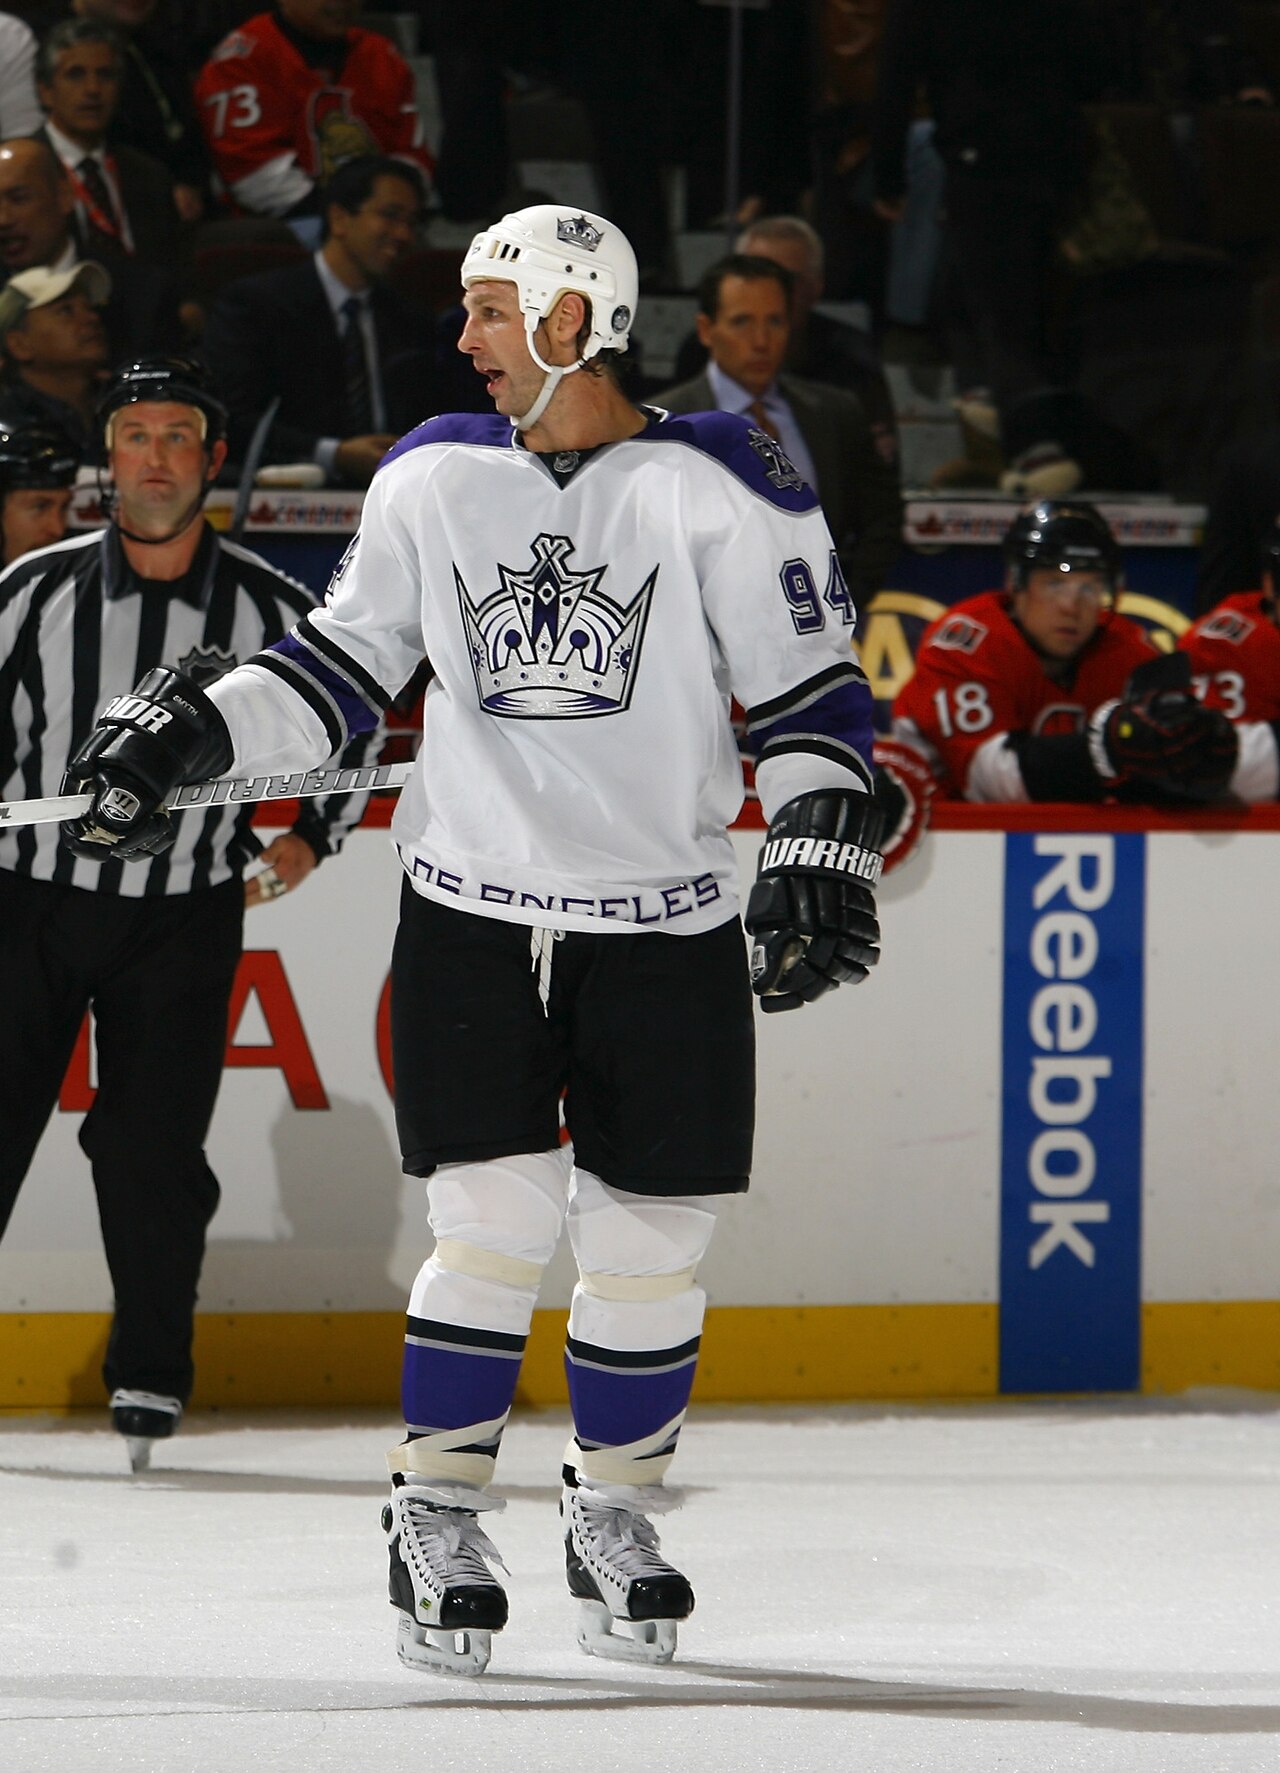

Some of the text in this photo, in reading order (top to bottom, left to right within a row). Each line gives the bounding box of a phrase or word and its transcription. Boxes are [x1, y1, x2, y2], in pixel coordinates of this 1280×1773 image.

[205, 84, 261, 138] 73
[779, 549, 857, 635] 94
[933, 682, 994, 738] 18
[1028, 833, 1116, 1269] Reebok
